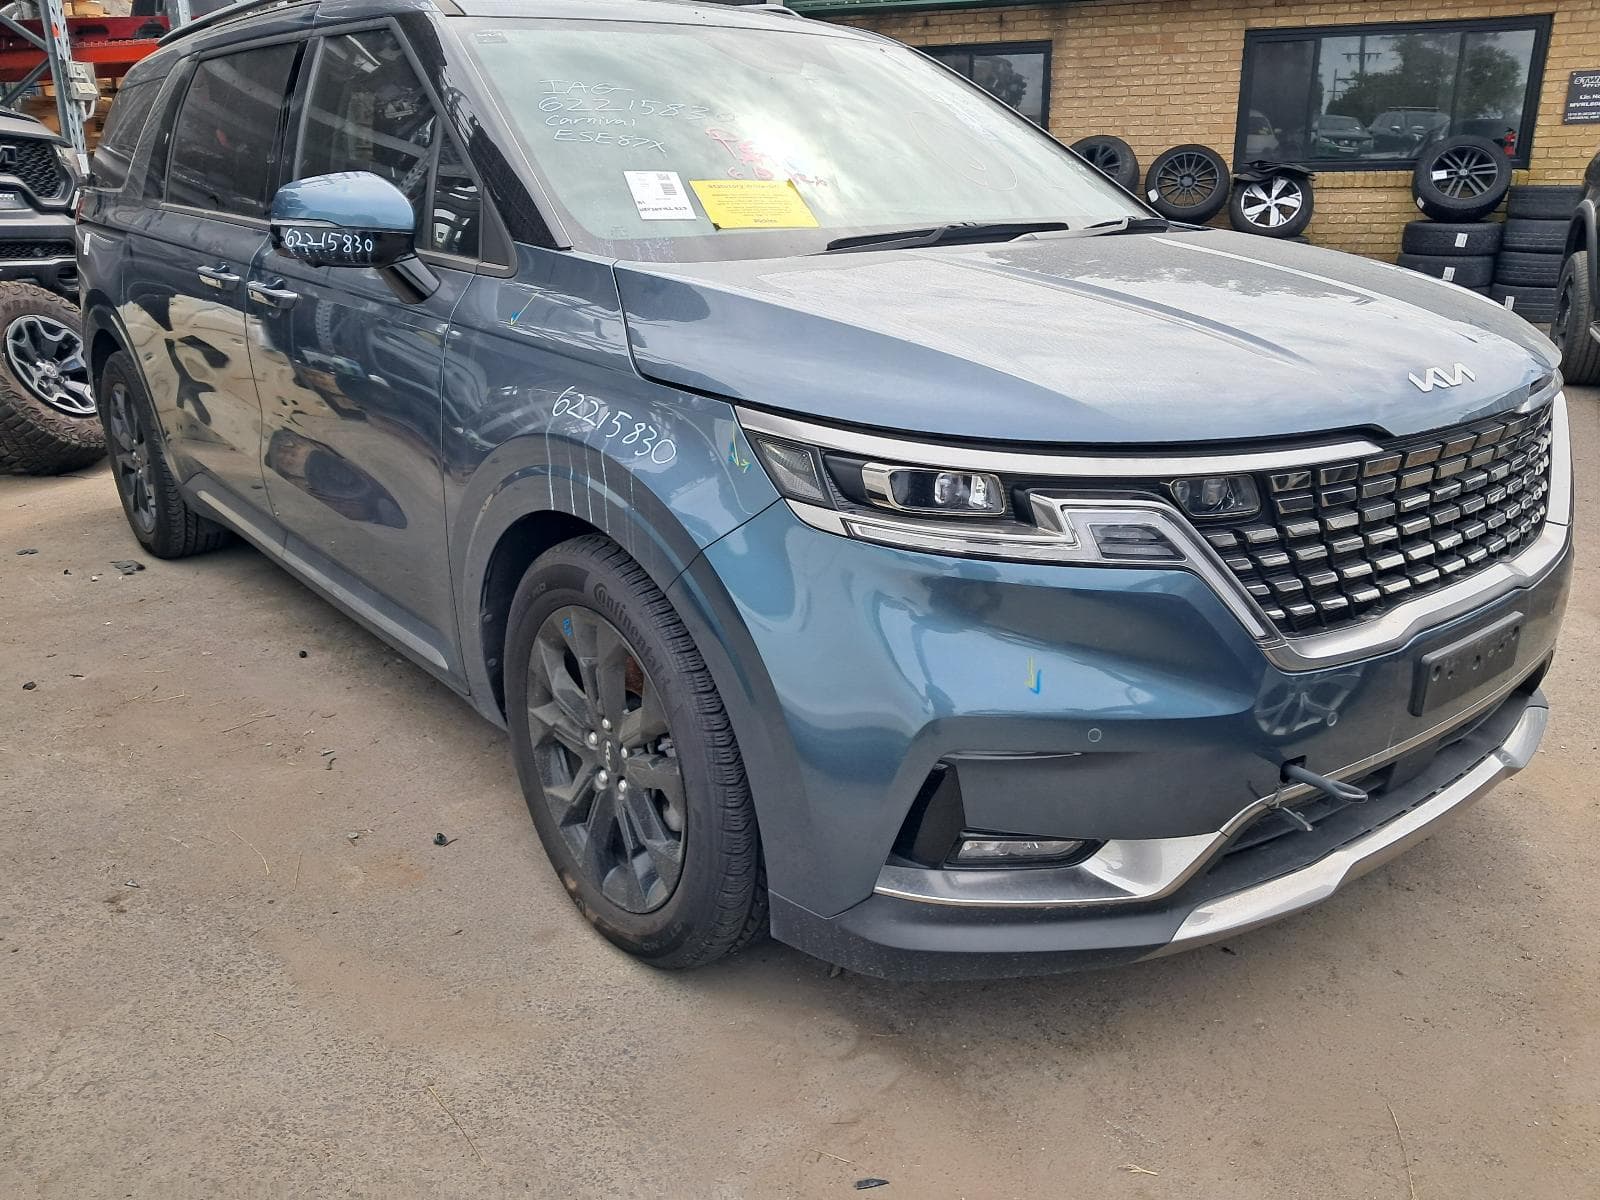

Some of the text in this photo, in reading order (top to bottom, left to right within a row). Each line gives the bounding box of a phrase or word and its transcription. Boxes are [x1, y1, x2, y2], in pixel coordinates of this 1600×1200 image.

[539, 79, 634, 95] IAG
[285, 228, 374, 254] 62215830
[552, 386, 677, 465] 62215830
